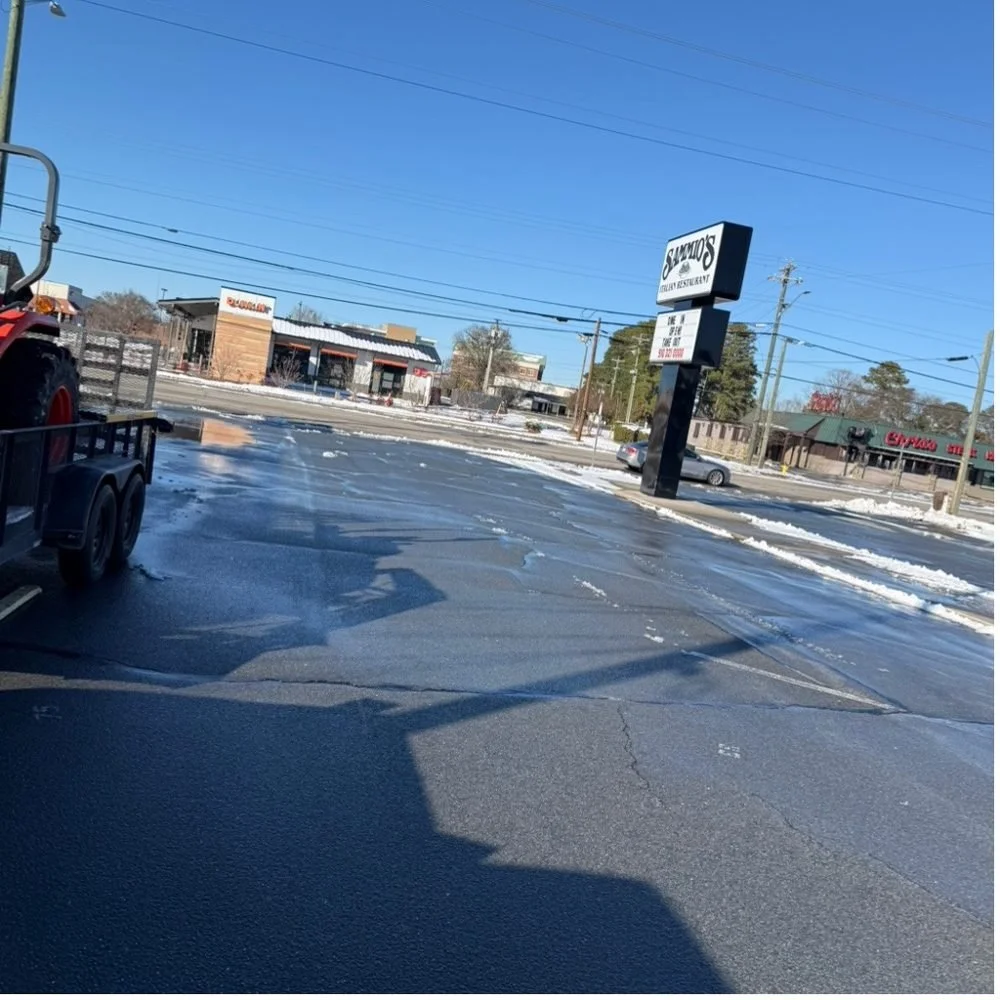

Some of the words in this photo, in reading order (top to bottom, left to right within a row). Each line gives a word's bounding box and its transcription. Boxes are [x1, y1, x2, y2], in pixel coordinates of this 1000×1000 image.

[662, 234, 716, 281] SAMMIO'S
[660, 282, 676, 292] ITALIAN
[677, 274, 710, 289] RESTAURANT
